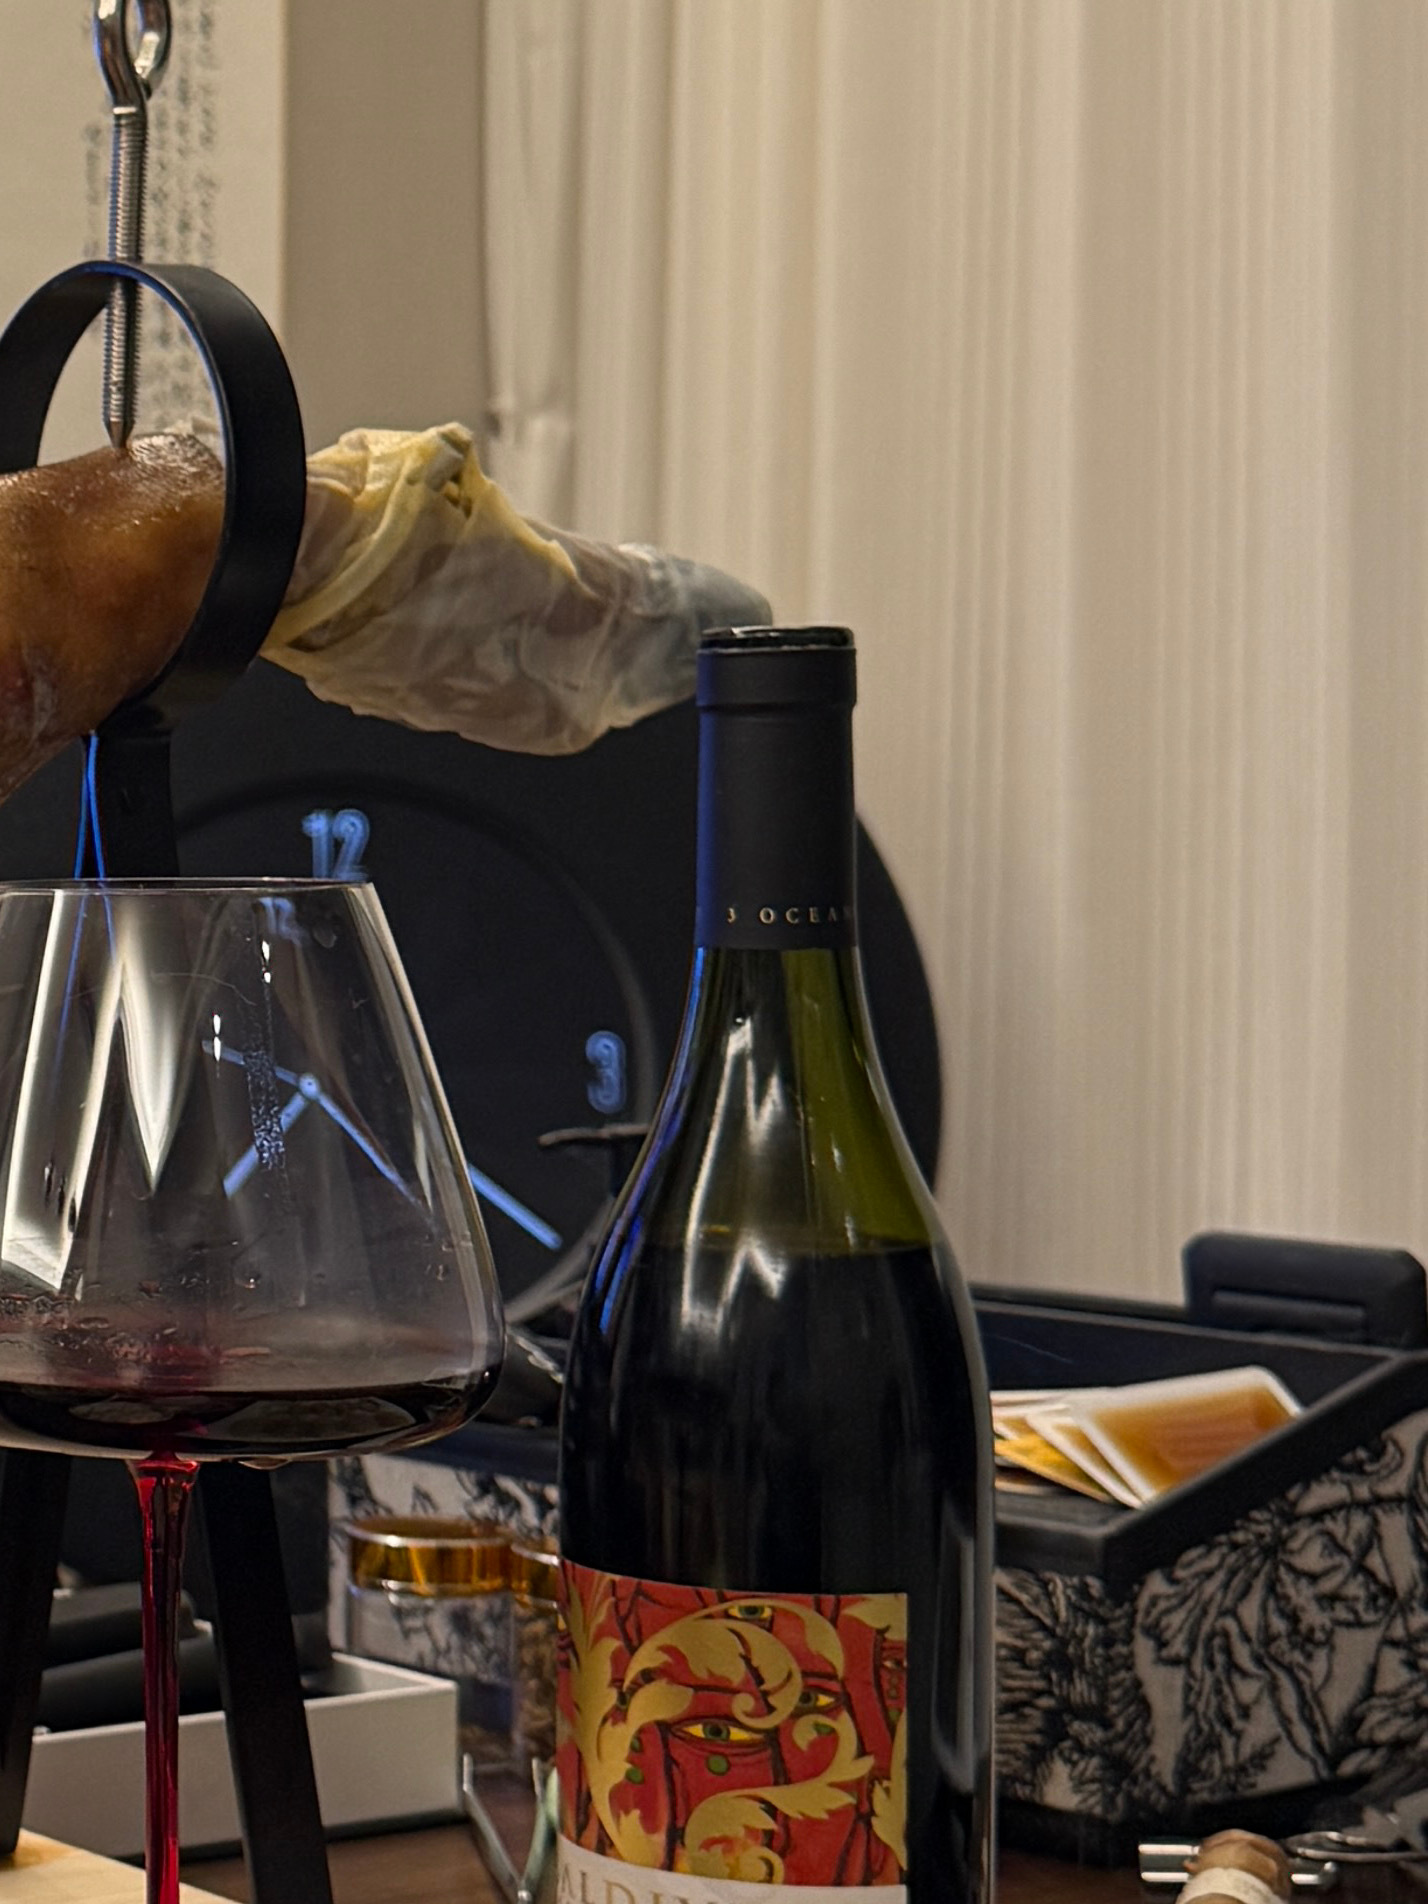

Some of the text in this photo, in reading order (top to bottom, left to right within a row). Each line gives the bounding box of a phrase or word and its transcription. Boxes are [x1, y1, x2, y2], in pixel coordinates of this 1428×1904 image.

[301, 808, 371, 883] 12
[726, 906, 851, 924] 3 OCEA
[585, 1030, 628, 1114] 3
